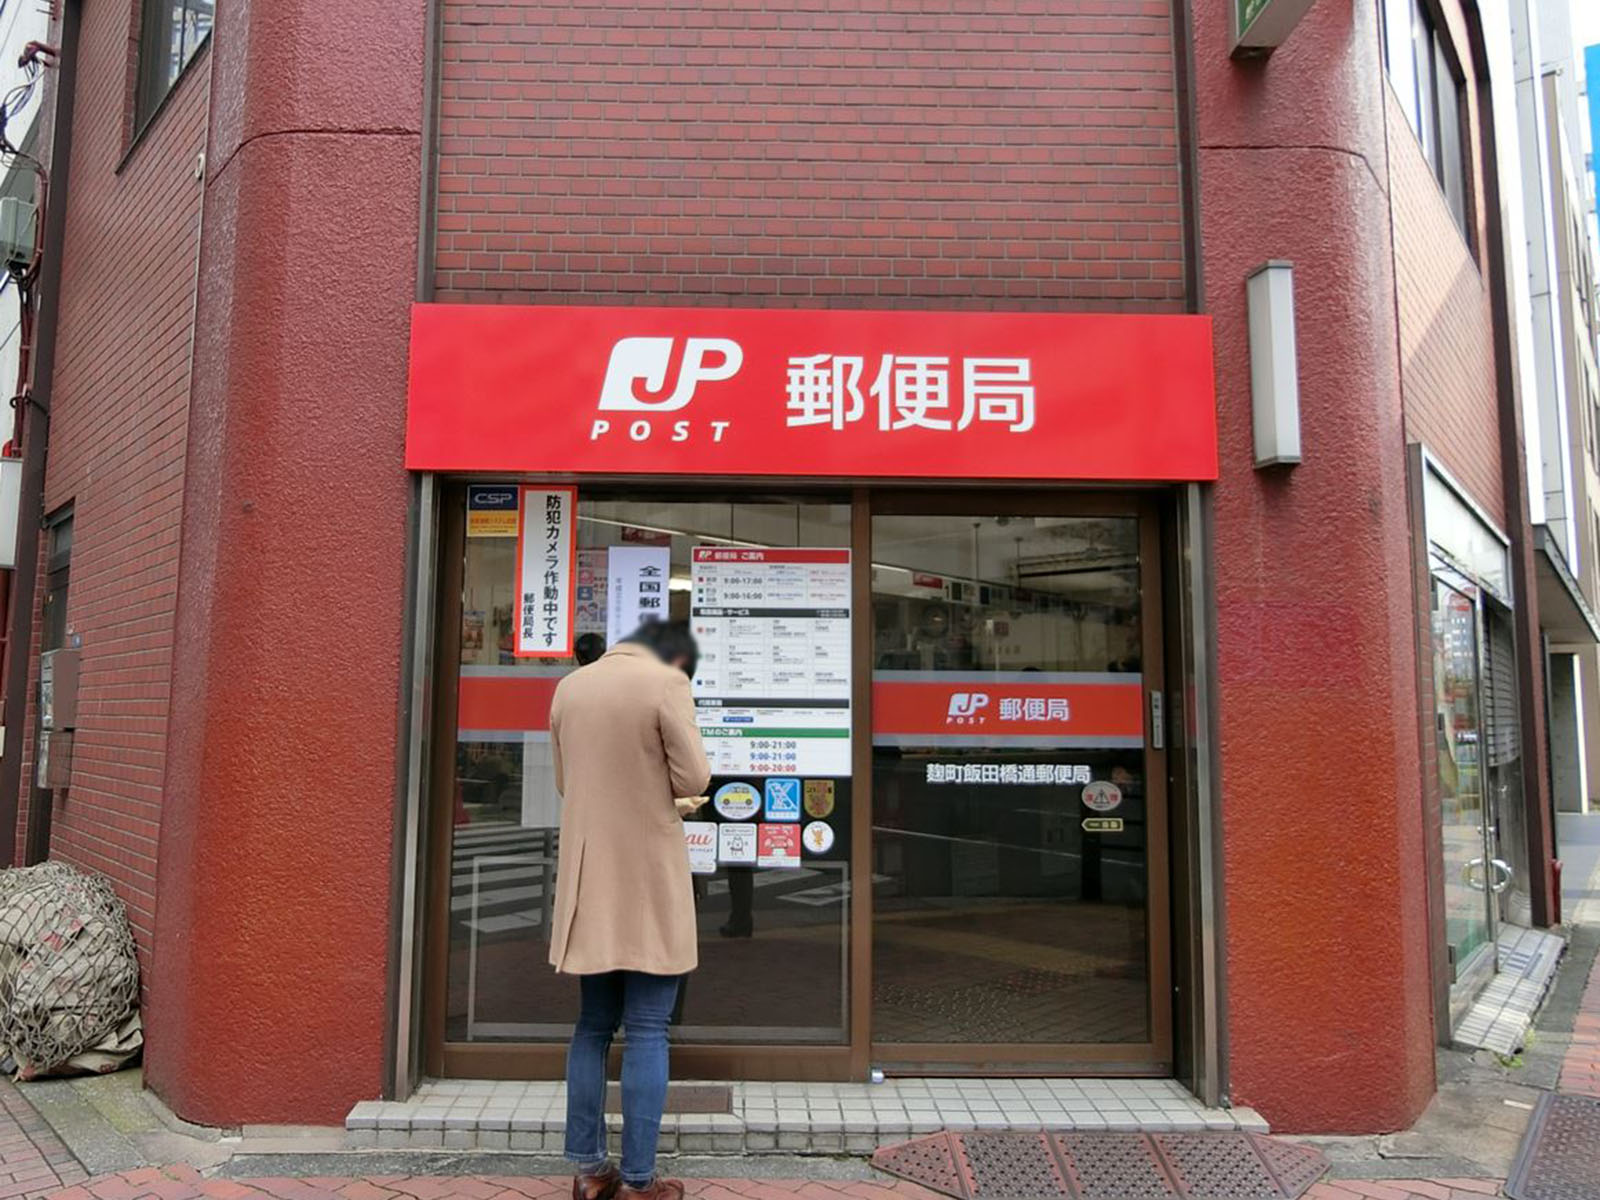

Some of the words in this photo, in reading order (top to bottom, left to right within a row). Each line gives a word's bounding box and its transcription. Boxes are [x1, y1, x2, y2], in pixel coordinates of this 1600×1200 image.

[597, 336, 744, 412] JP
[785, 353, 1036, 433] 郵便局
[590, 419, 731, 443] POST
[474, 492, 513, 504] CSP
[542, 493, 562, 647] 防犯カメラ作動中です
[523, 591, 536, 640] 郵便局長
[999, 697, 1070, 722] 郵便局
[749, 740, 797, 749] 9:00-21:00
[749, 751, 797, 761] 9:00-21:00
